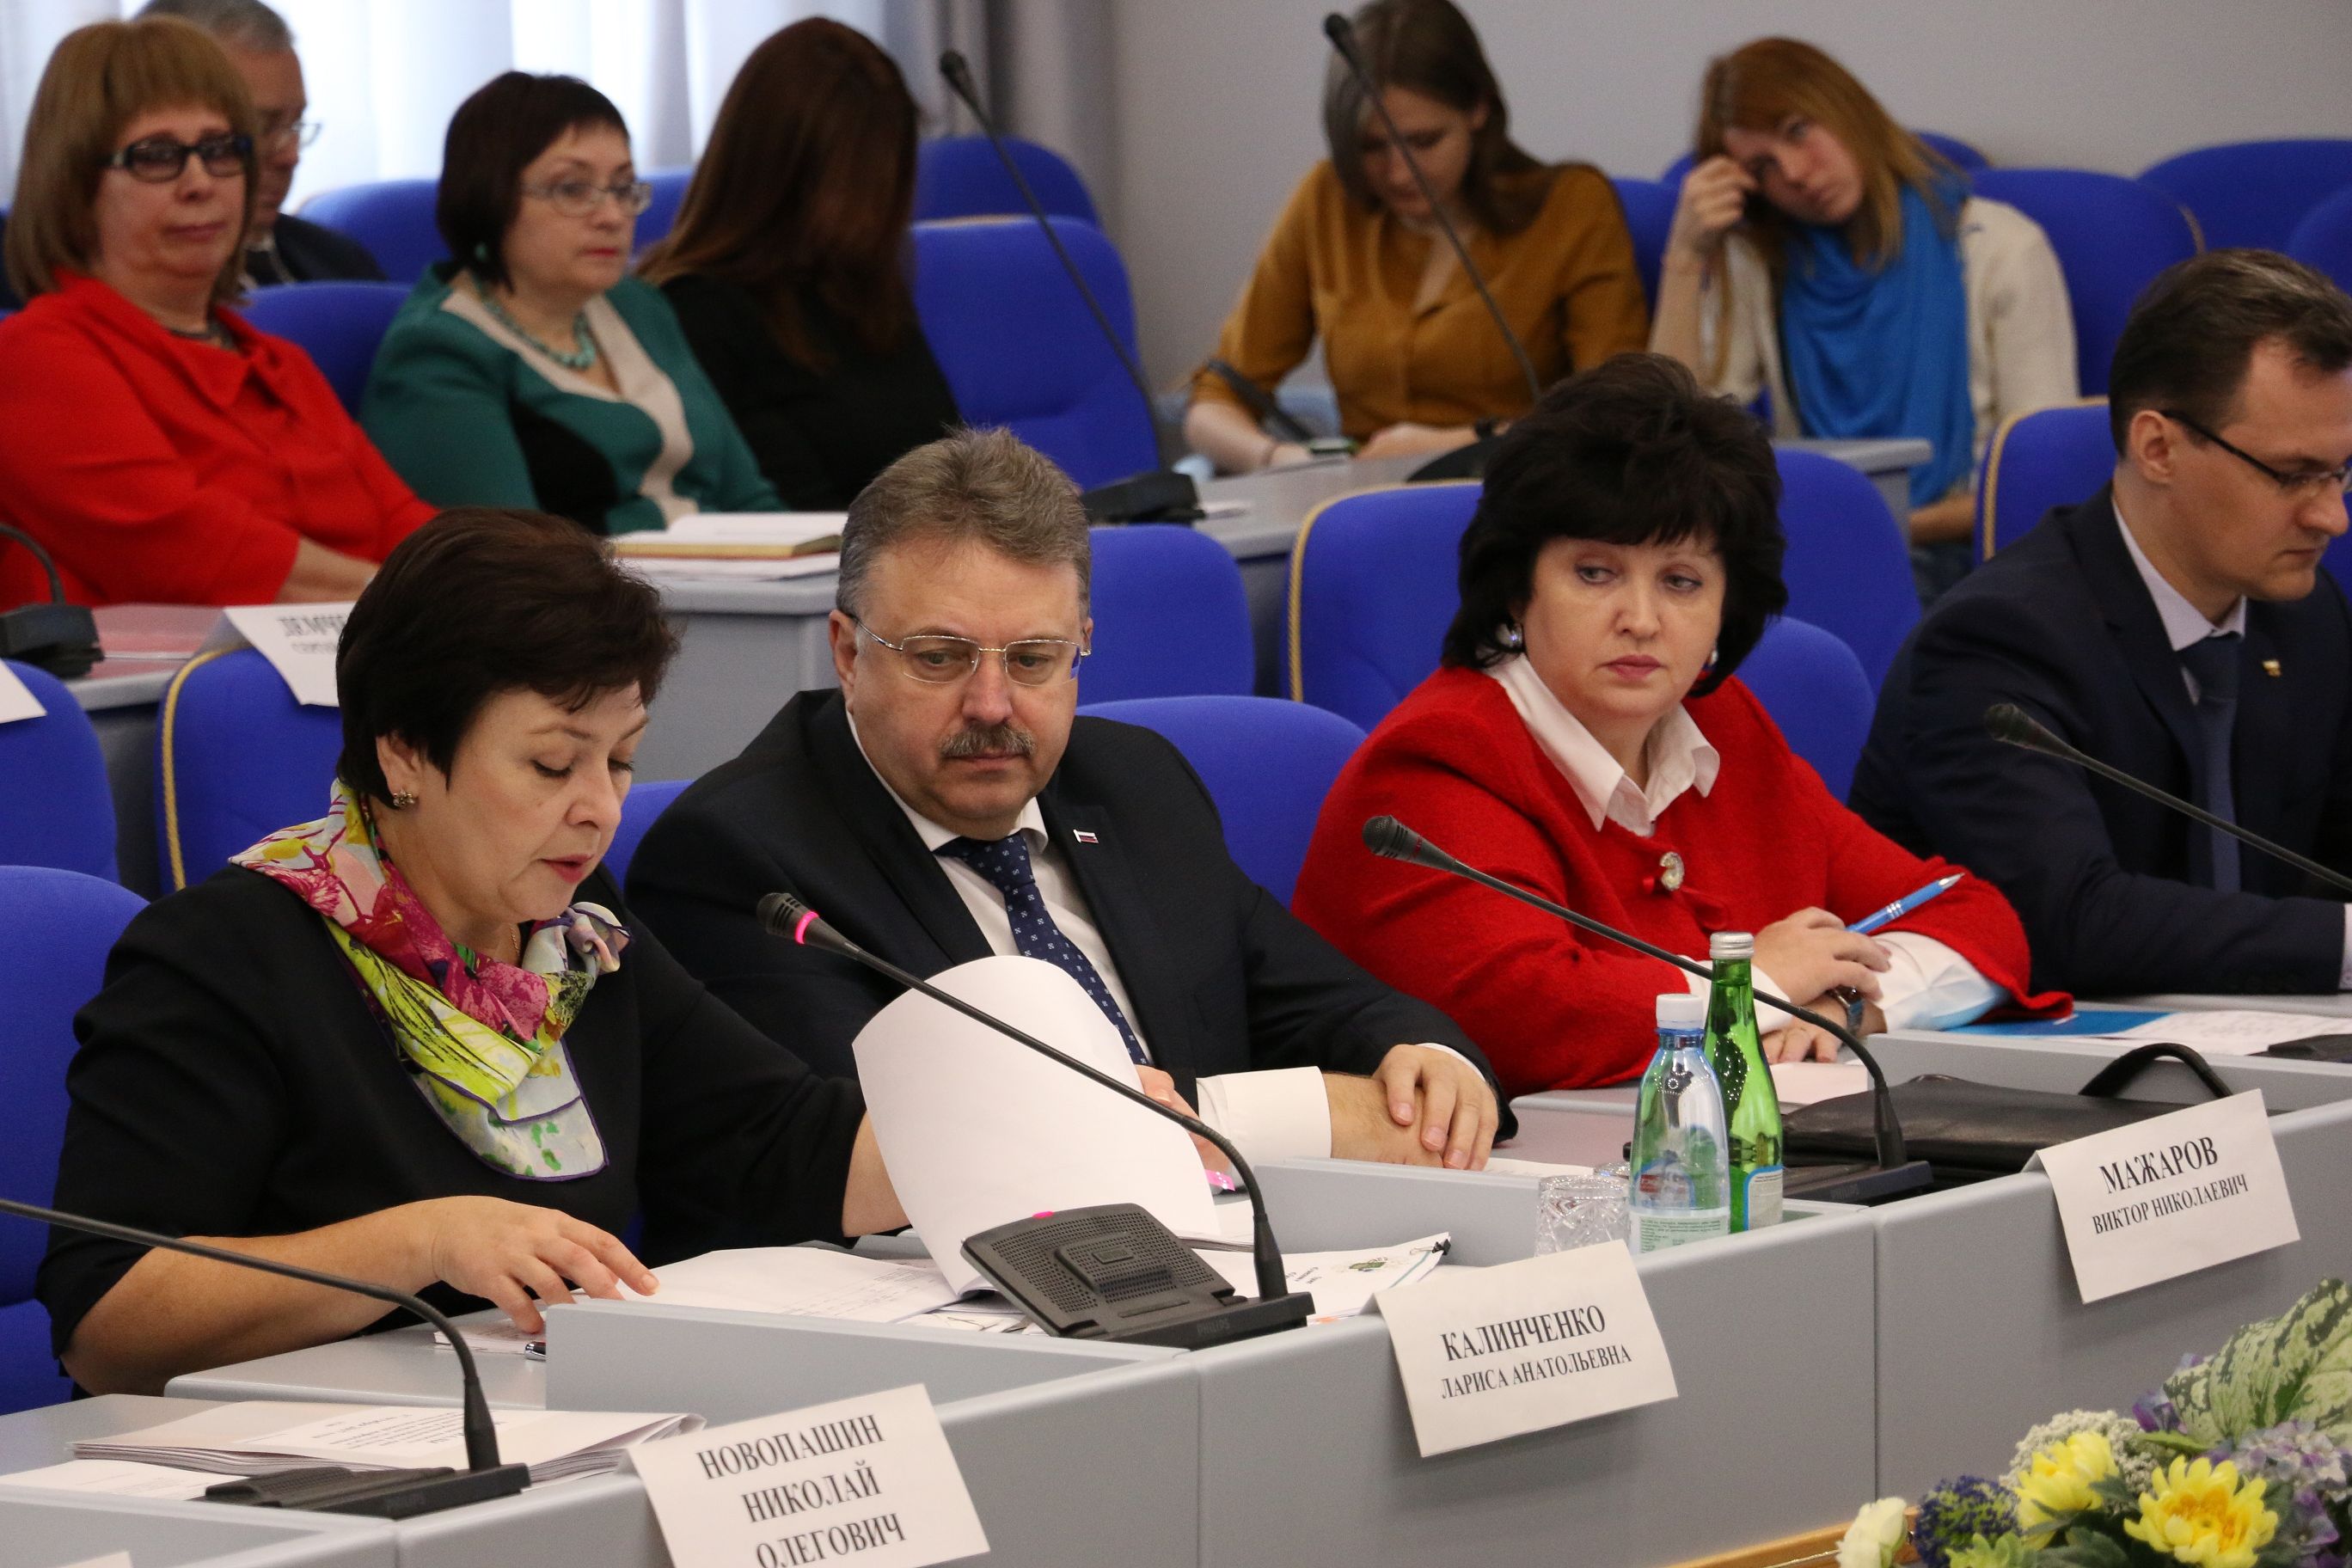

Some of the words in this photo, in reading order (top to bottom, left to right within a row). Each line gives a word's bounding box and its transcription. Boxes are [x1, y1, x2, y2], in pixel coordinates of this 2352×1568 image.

[2098, 1136, 2219, 1194] МАЖАРОВ
[2092, 1202, 2150, 1234] ВИКТОР
[2152, 1173, 2249, 1217] НИКОЛАЕВИЧ
[1440, 1305, 1606, 1361] КАЛИНЧЕНКО
[1441, 1368, 1510, 1400] ЛАРИСА
[1513, 1344, 1632, 1385] АНАТОЛЬЕВНА
[696, 1415, 885, 1479] НОВОПАШИН
[740, 1460, 883, 1523] НИКОЛАЙ
[756, 1513, 906, 1568] ОЛЕГОВИЧ
